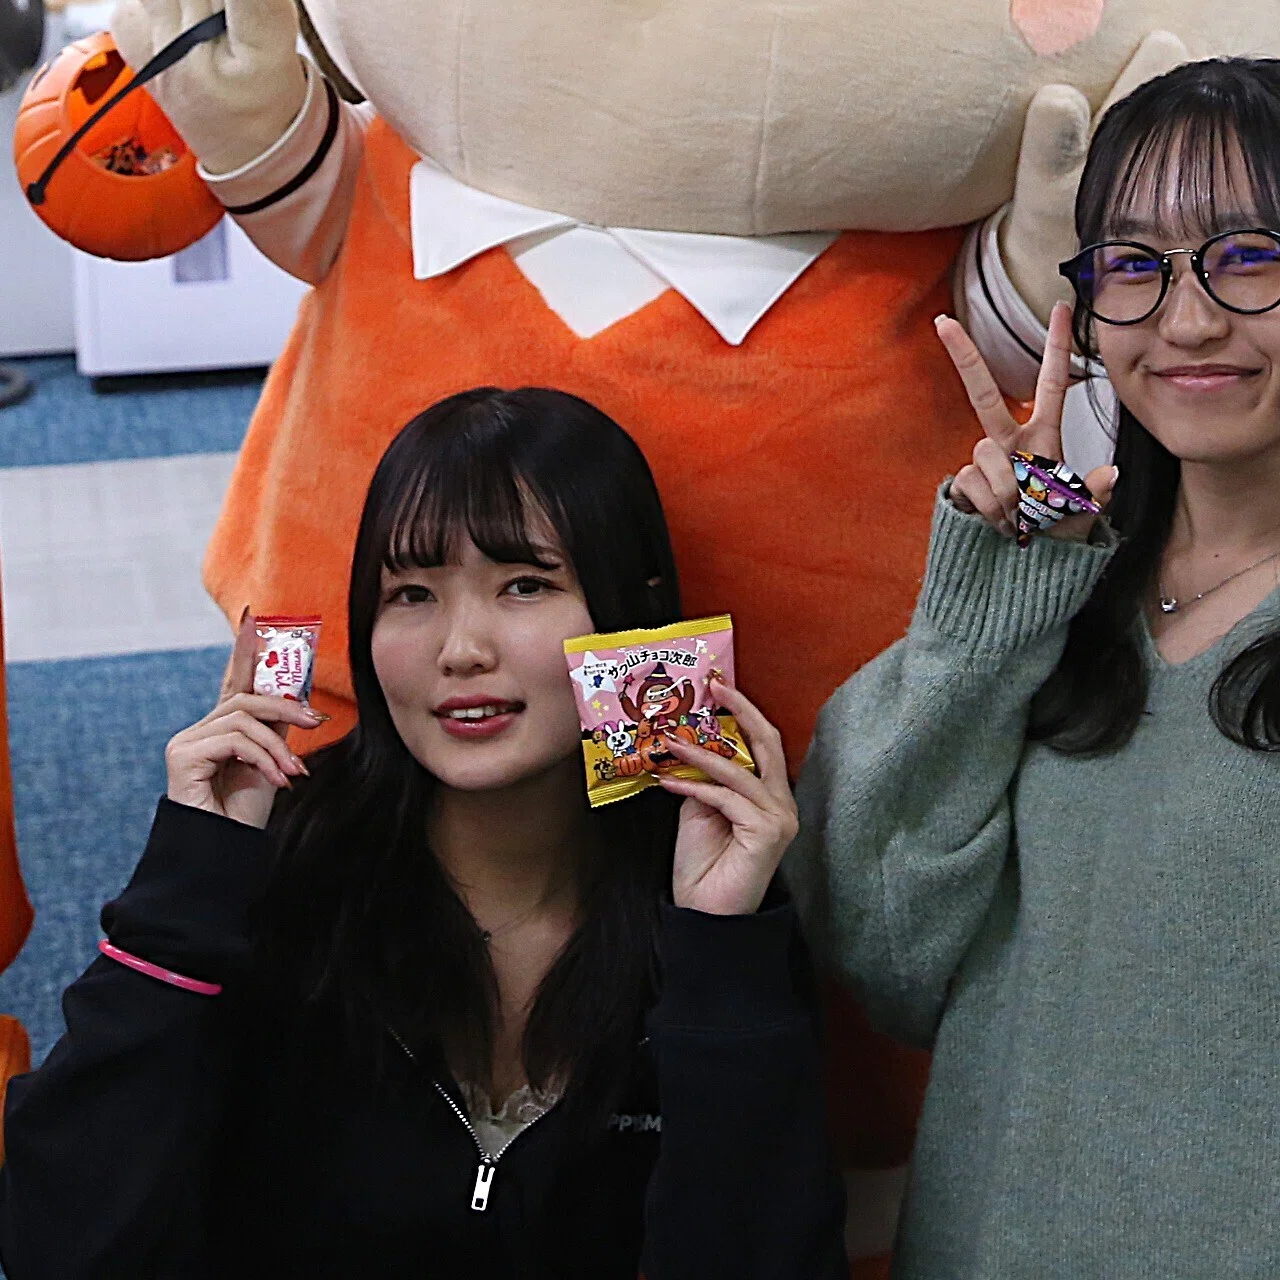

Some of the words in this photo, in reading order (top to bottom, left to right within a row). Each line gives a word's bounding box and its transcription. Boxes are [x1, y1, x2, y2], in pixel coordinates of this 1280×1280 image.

[291, 648, 303, 684] Mouse
[608, 650, 698, 679] サク山チョコ次郎
